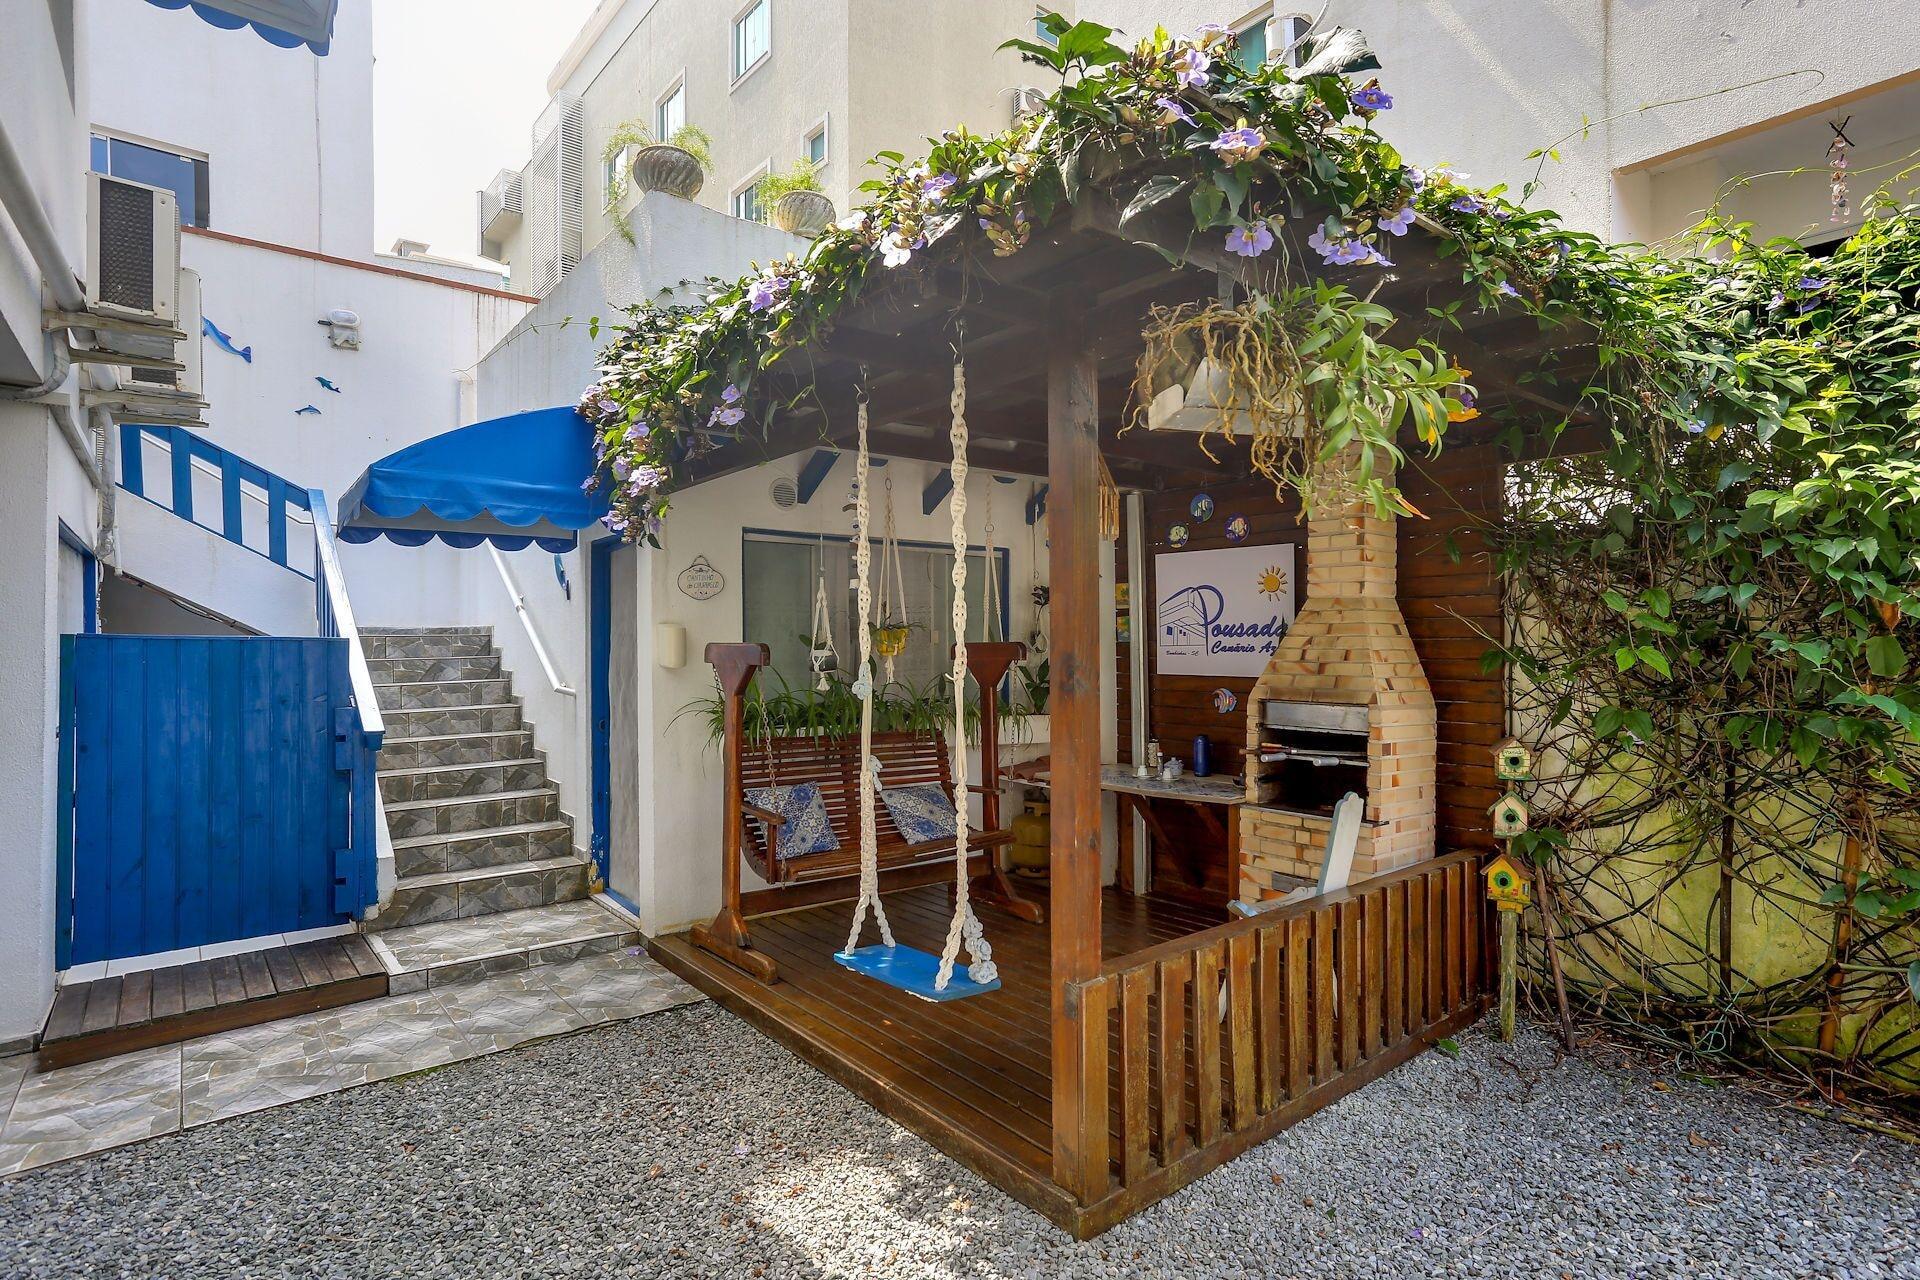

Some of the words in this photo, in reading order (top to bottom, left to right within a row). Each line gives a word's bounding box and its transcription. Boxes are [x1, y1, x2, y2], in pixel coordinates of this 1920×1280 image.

[1190, 584, 1289, 656] Pousada
[1210, 640, 1256, 655] Canário
[1258, 640, 1277, 657] Az
